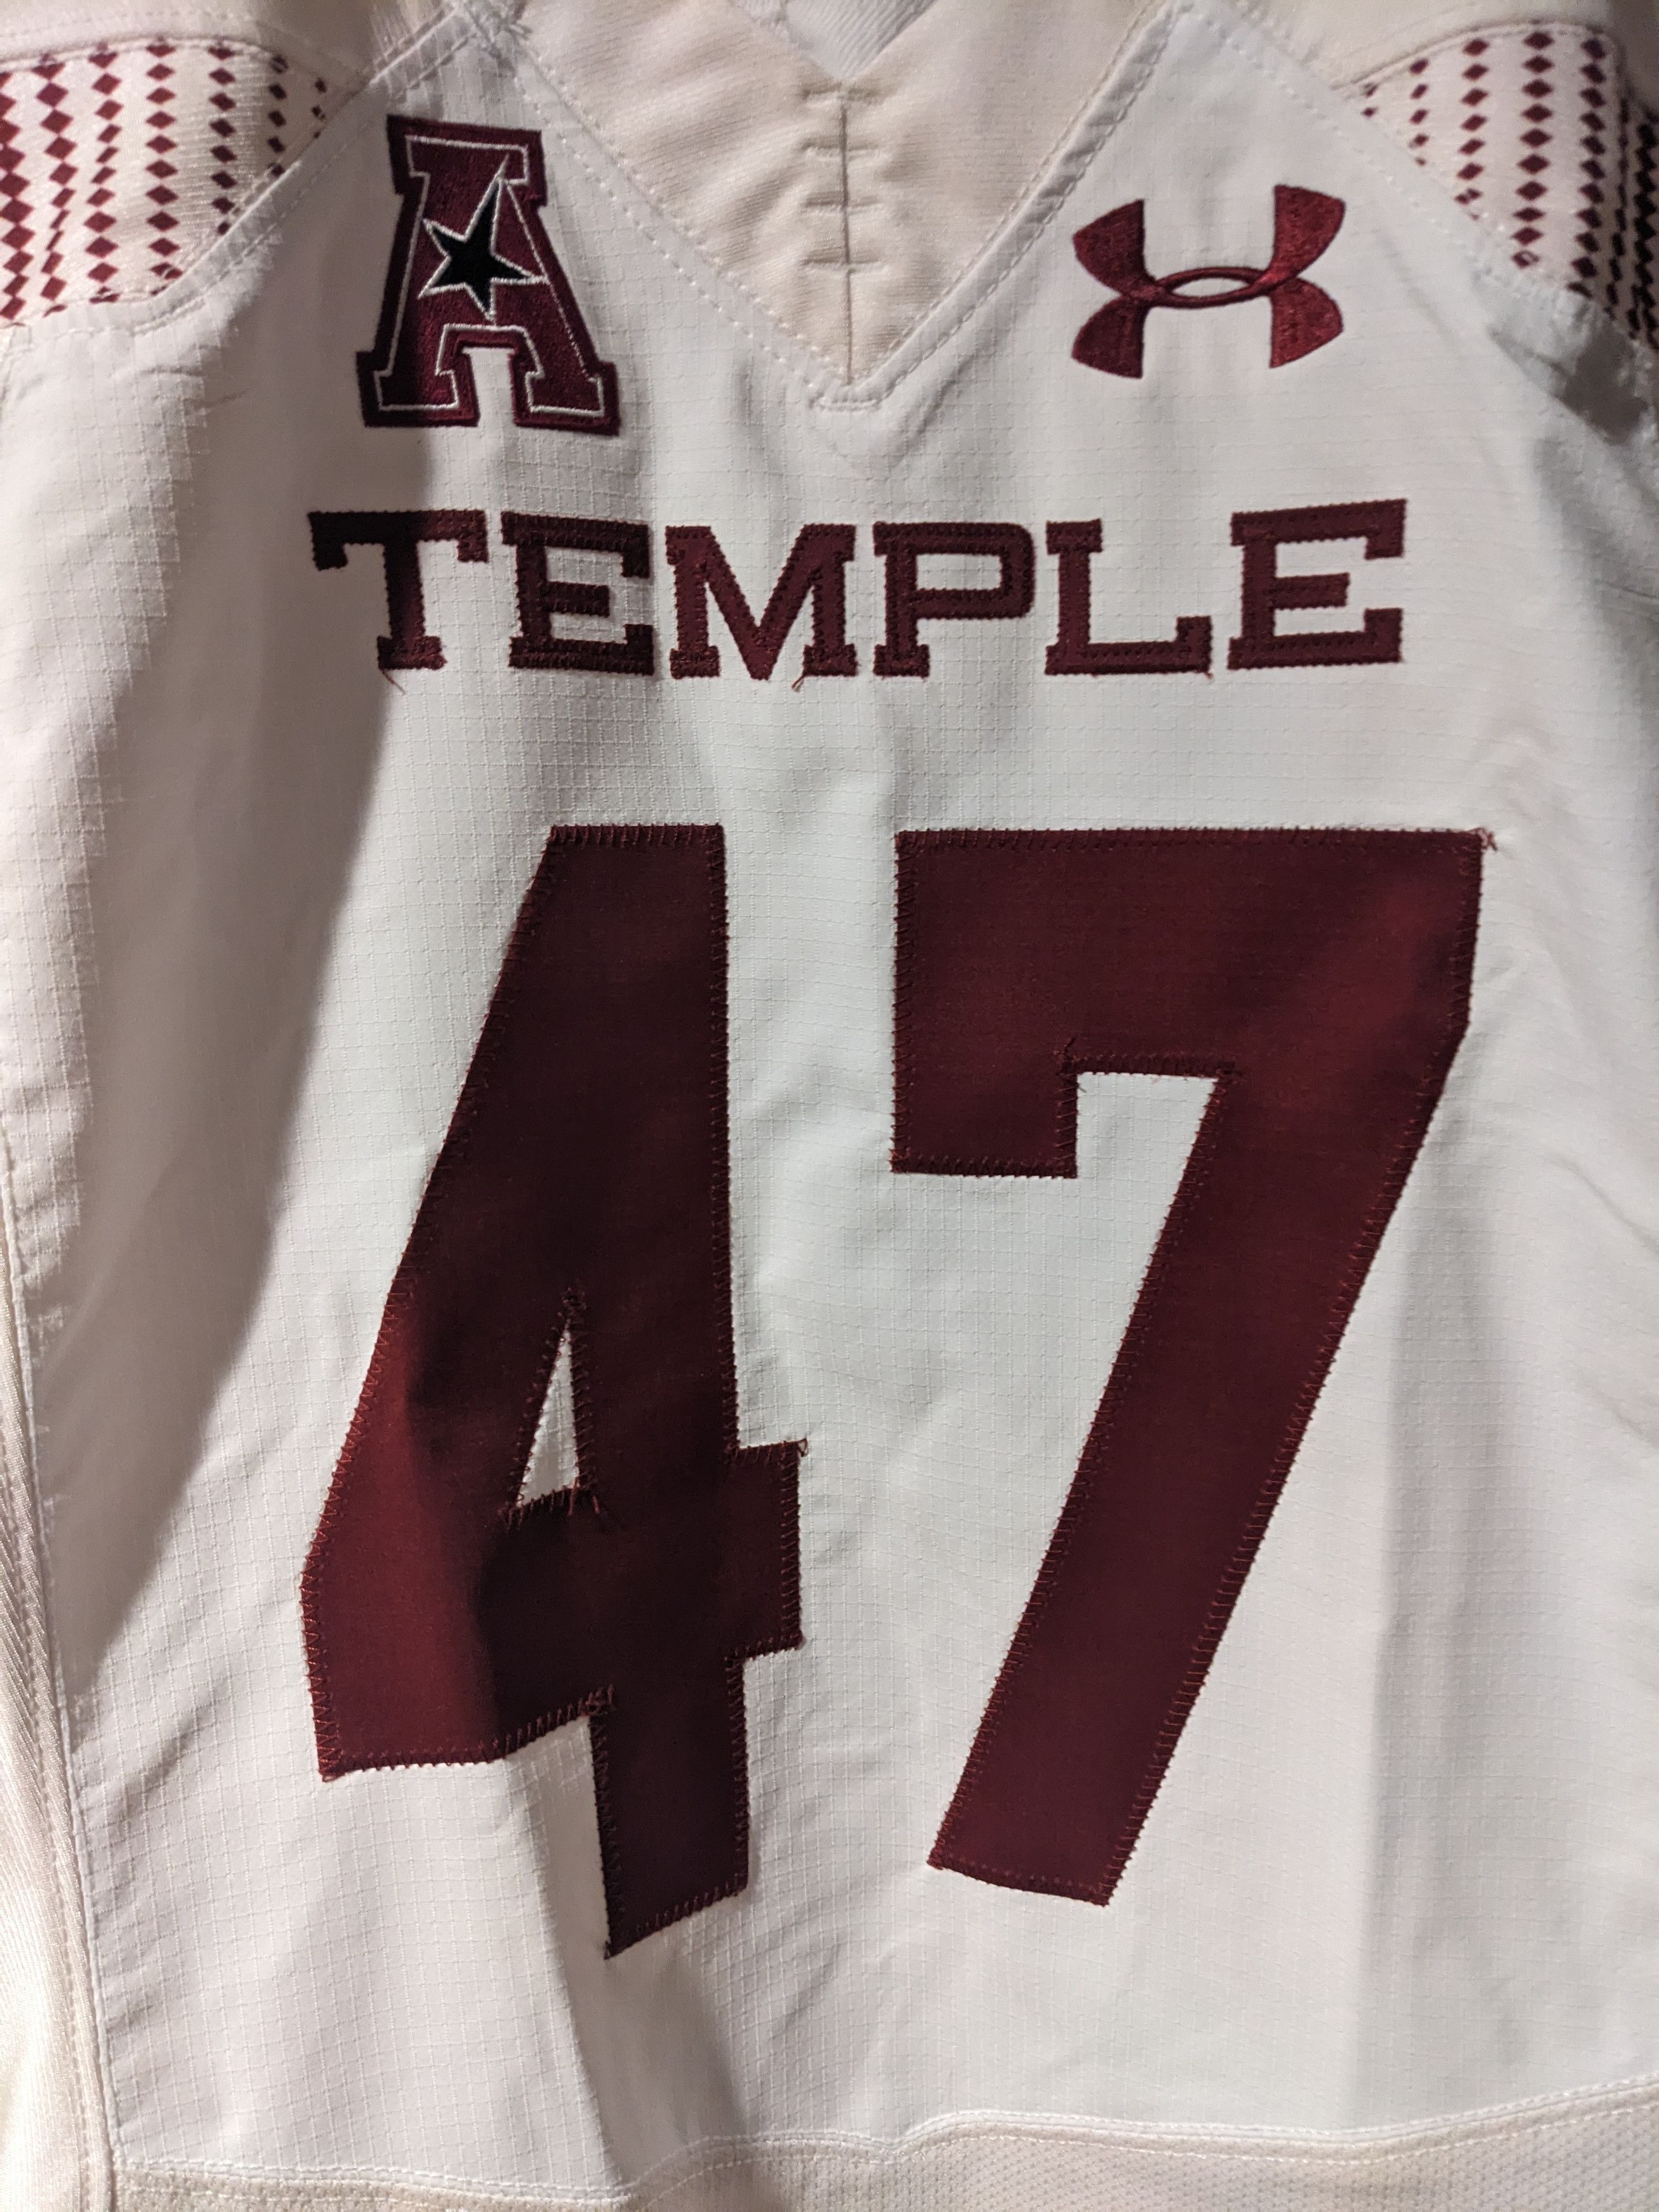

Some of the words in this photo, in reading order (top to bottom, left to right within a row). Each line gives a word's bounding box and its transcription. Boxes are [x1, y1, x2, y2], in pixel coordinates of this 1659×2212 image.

[356, 114, 621, 436] A
[308, 499, 1406, 680] TEMPLE
[303, 824, 1486, 1959] 47
